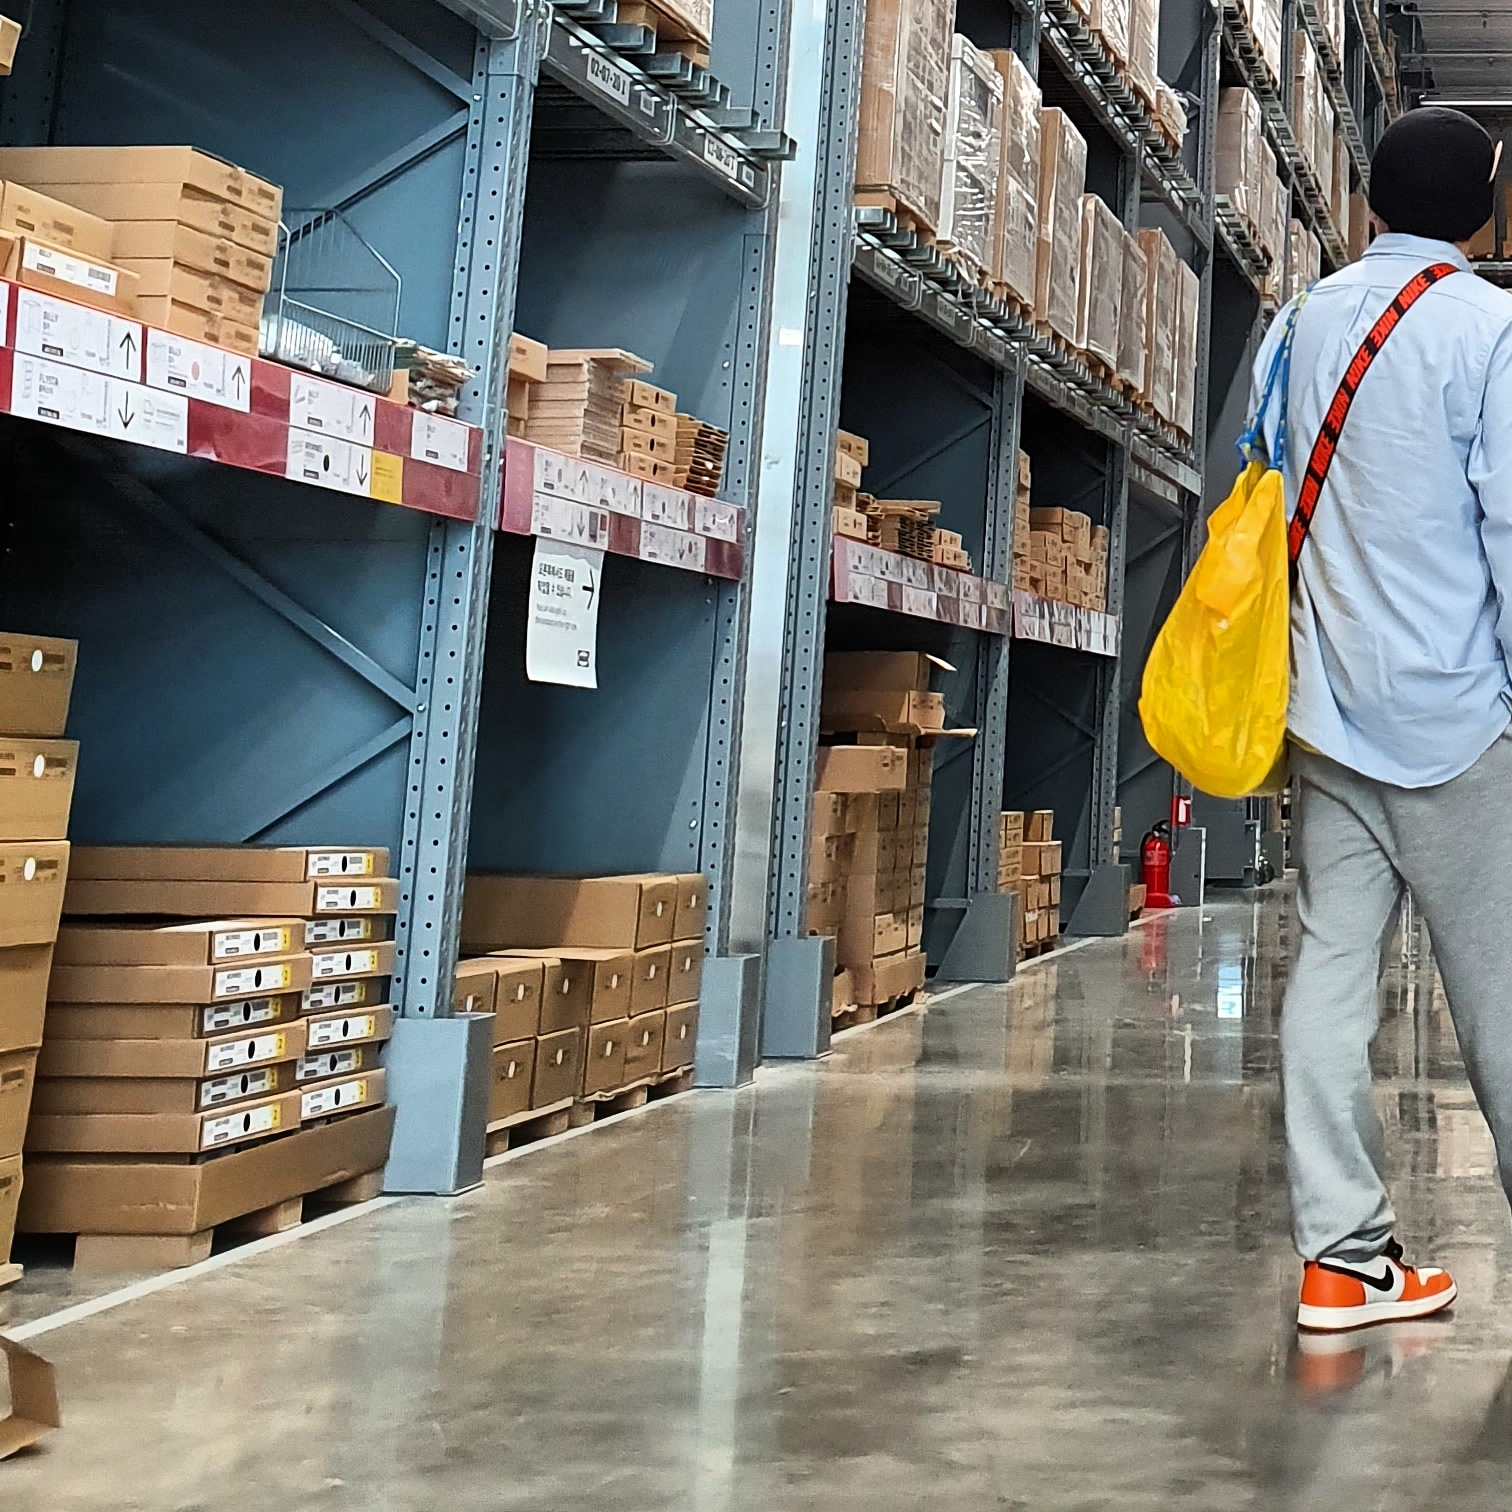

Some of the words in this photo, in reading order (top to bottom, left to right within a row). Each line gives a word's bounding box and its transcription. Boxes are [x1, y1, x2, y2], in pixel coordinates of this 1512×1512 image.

[1398, 273, 1431, 311] NIKE
[1369, 306, 1399, 349] NIKE
[1346, 344, 1373, 390] NIKE
[1327, 387, 1350, 435] NIKE
